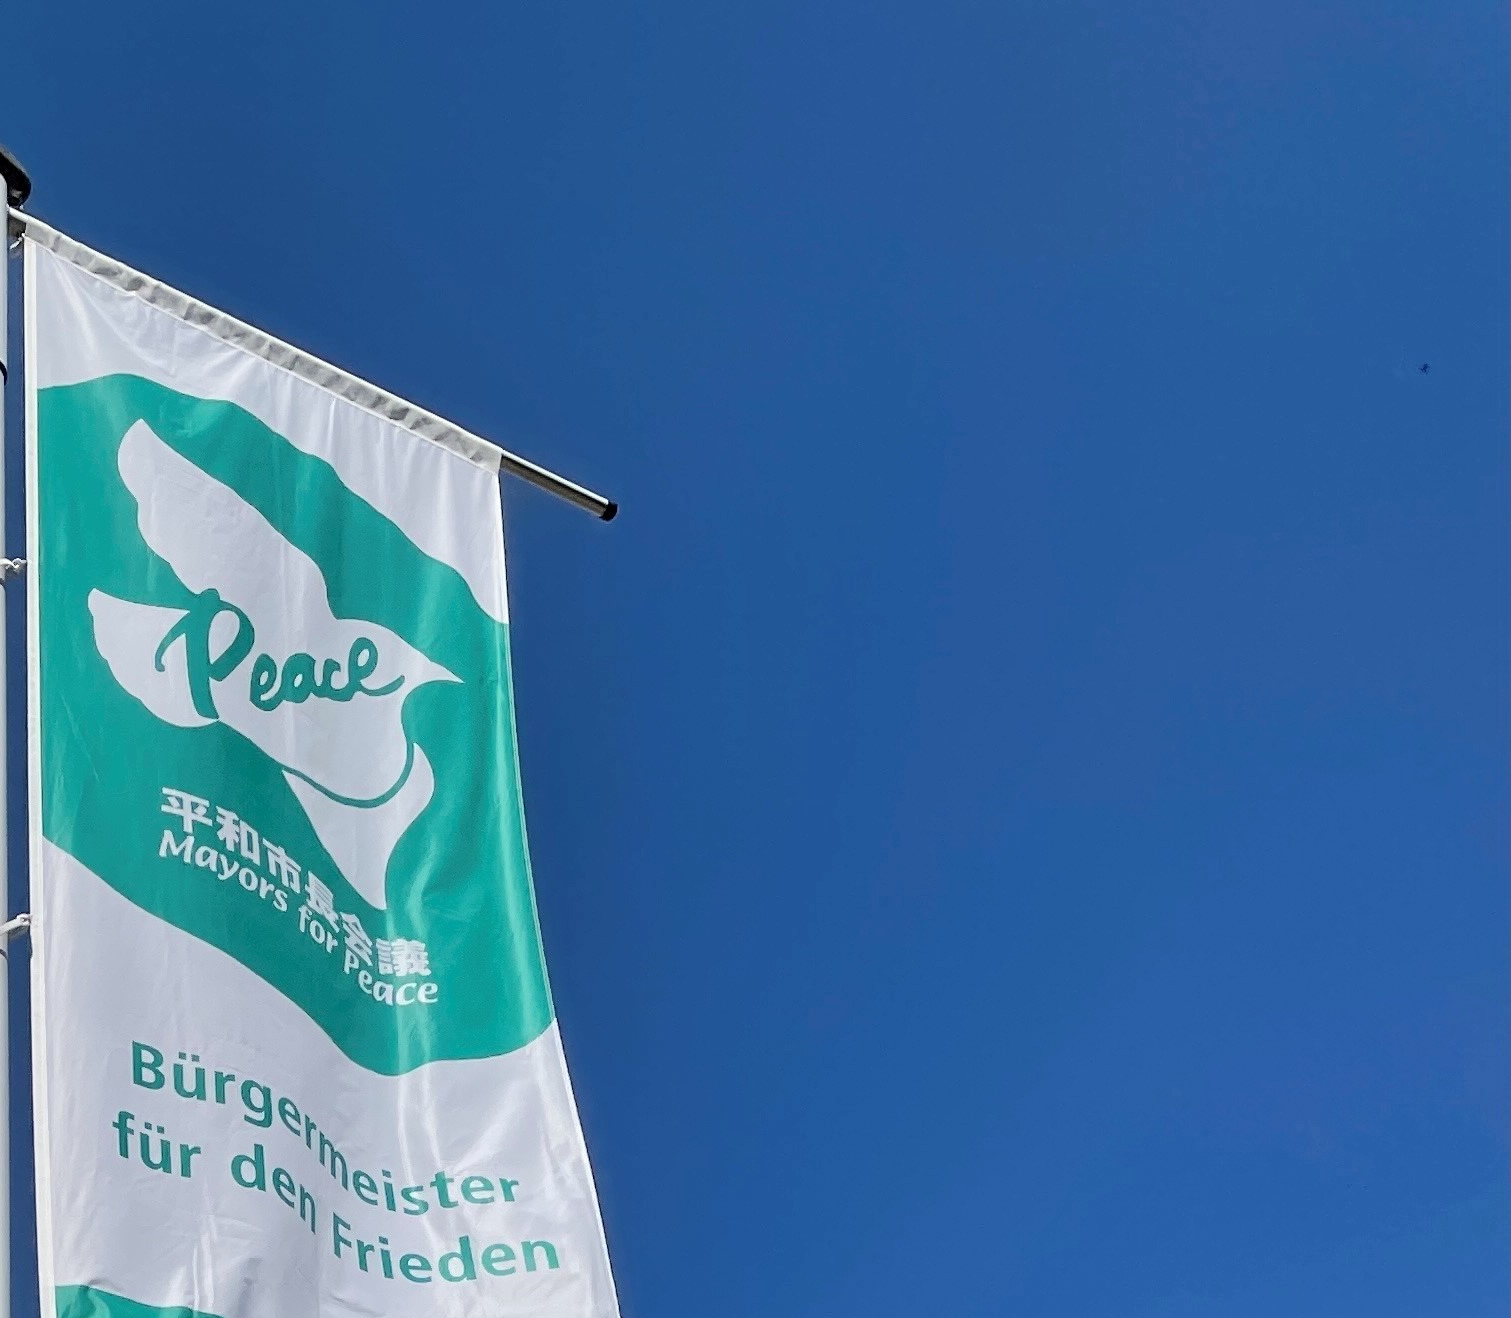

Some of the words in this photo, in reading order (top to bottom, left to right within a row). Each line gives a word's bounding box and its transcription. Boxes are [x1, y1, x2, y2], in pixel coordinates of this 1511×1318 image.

[155, 588, 406, 720] Peace
[158, 829, 289, 912] Mayors
[297, 904, 339, 954] for
[343, 948, 439, 1006] Peace
[160, 786, 432, 977] 平和市長会議
[112, 1110, 201, 1178] für
[231, 1143, 317, 1234] den
[331, 1213, 561, 1284] Frieden
[131, 1040, 520, 1217] Bürgermeister
